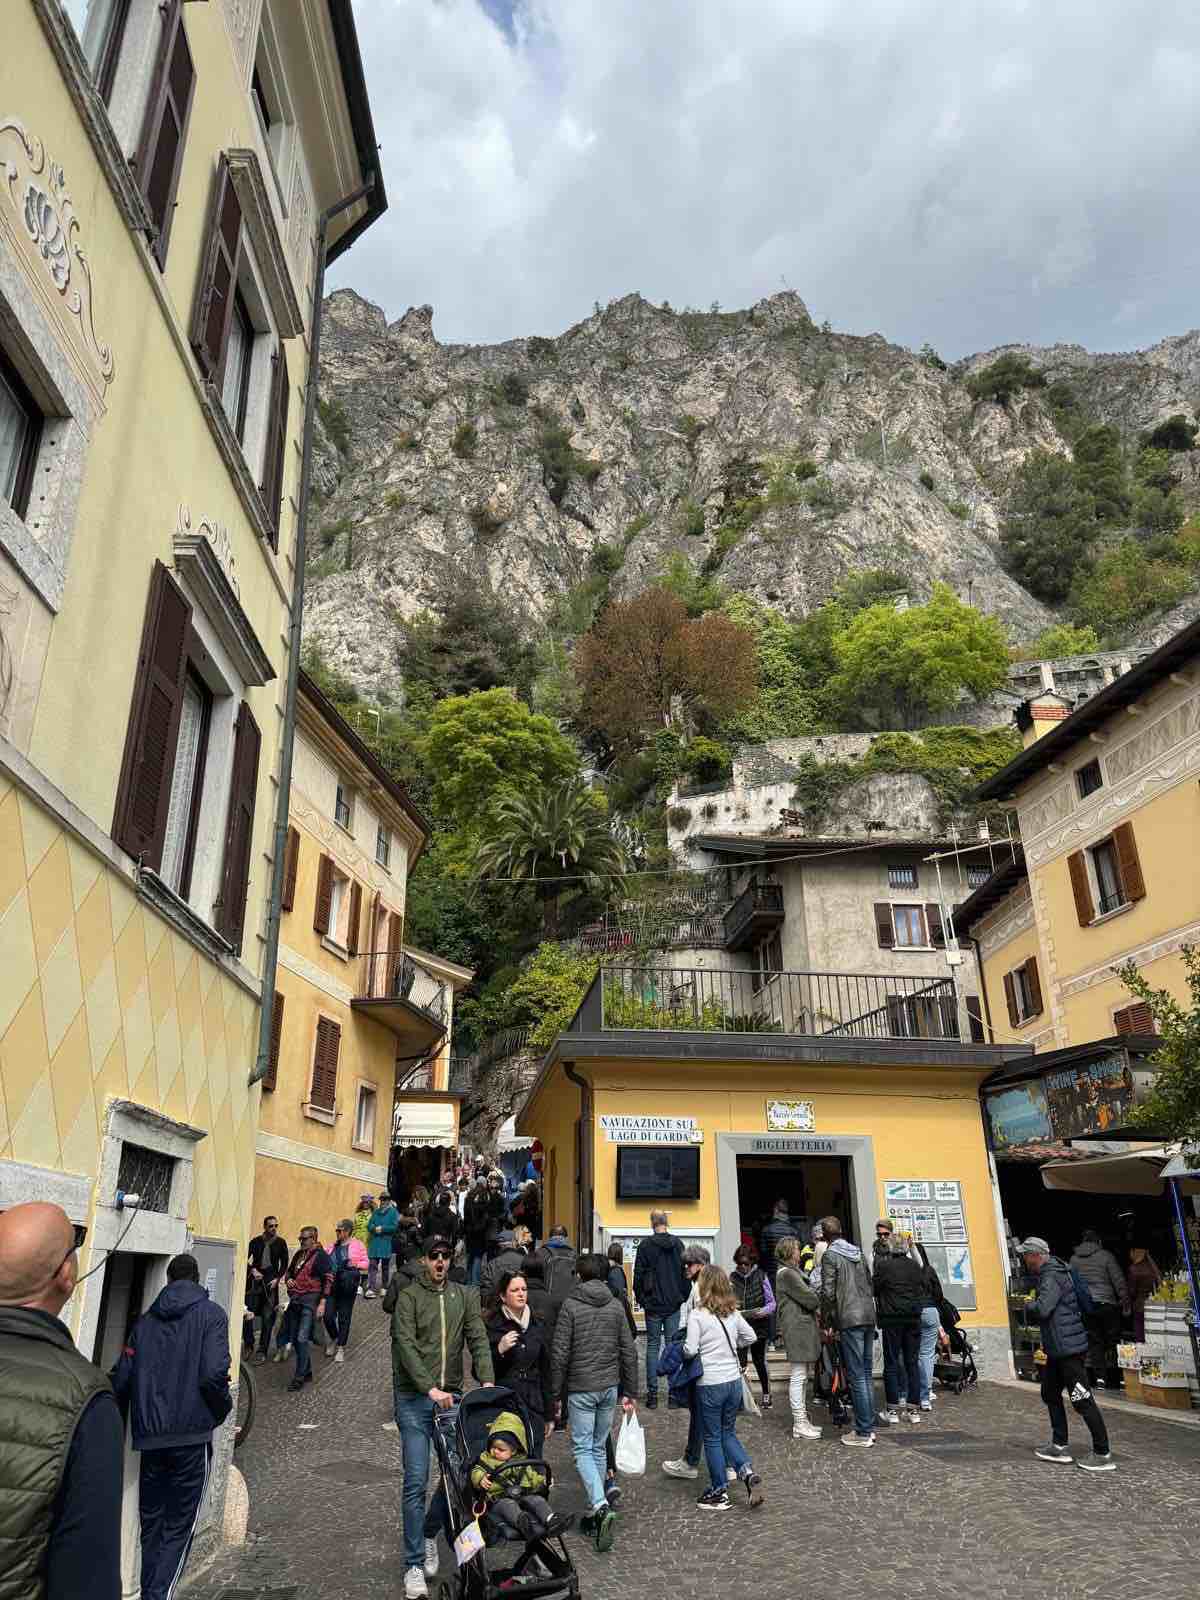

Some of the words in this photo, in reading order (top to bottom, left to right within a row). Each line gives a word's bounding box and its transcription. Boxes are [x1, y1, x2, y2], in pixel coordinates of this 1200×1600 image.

[601, 1116, 673, 1129] NAVIGAZIONE
[610, 1130, 637, 1141] LAGO
[640, 1131, 651, 1141] DI
[655, 1131, 689, 1142] GARDA
[756, 1139, 832, 1151] BIGLIETTERIA
